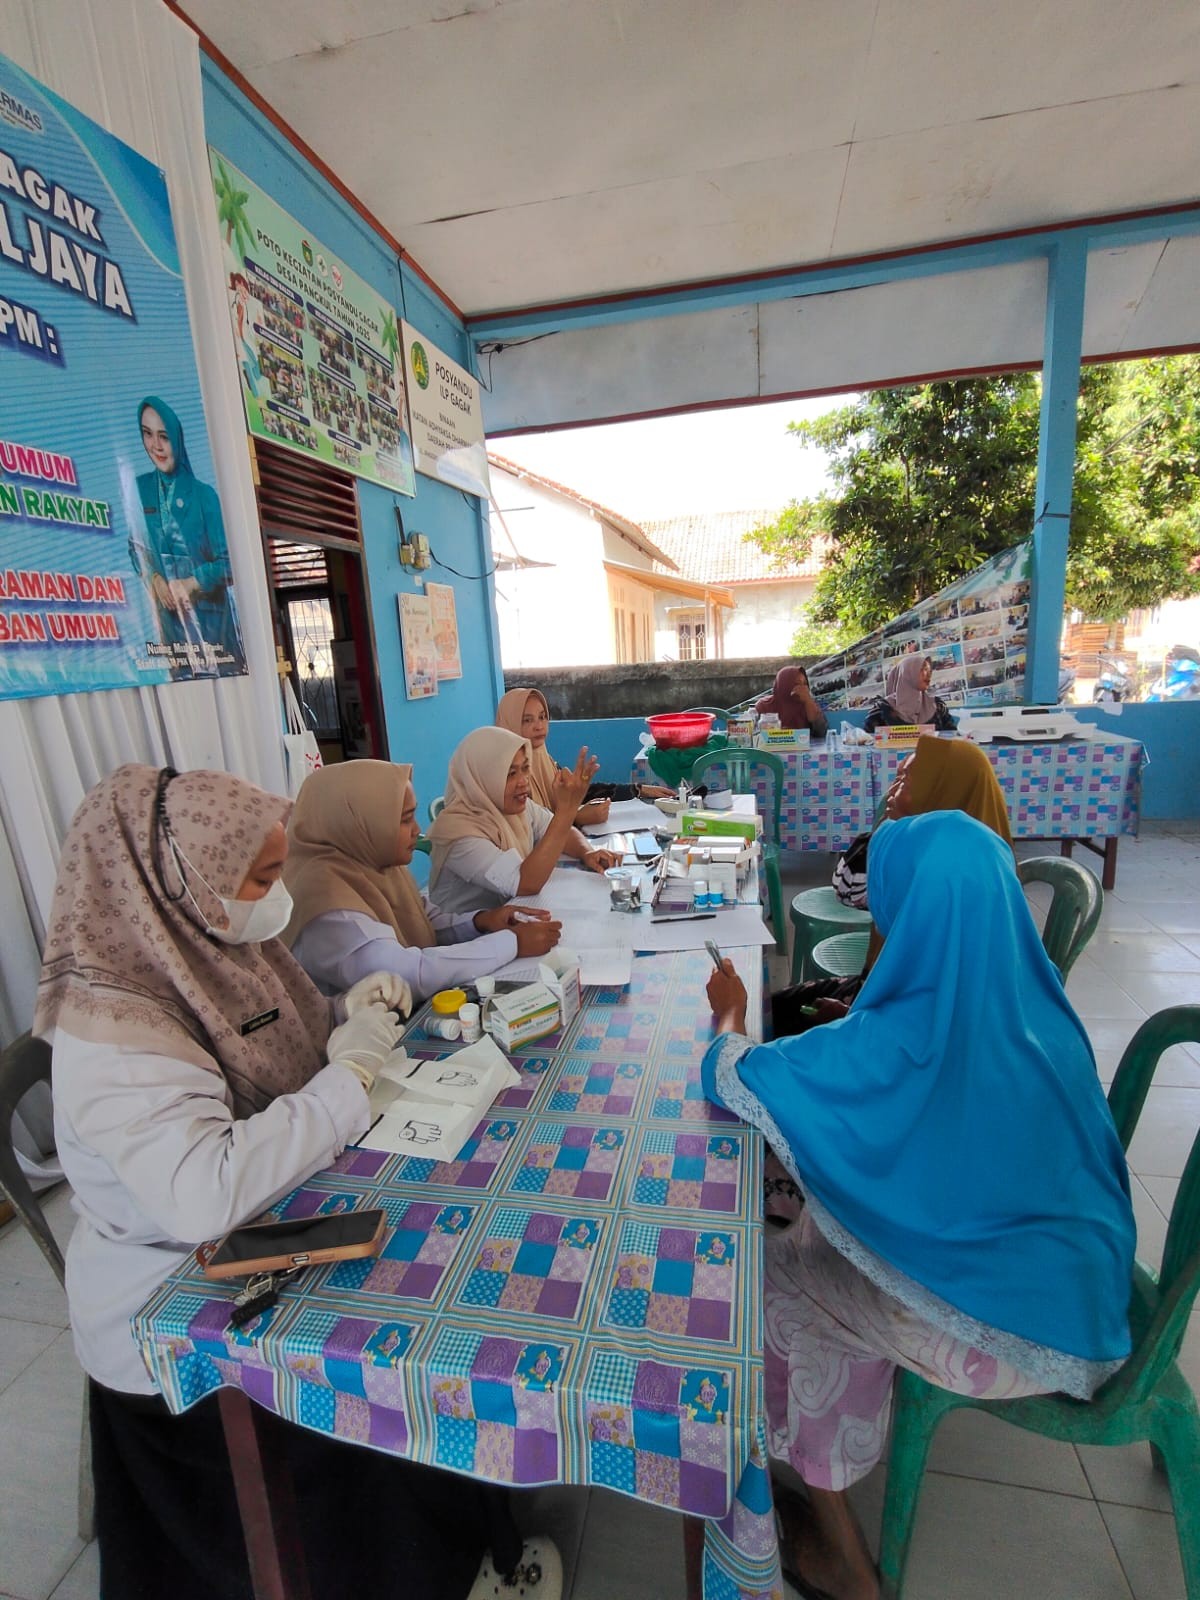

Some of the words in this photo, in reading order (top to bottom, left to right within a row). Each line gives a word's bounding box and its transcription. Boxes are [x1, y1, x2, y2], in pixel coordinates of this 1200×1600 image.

[0, 152, 102, 241] AGAK
[257, 228, 281, 257] POTO
[323, 281, 359, 318] POSYANDU
[276, 262, 297, 286] DESA
[333, 304, 355, 329] TAHUN
[435, 361, 473, 400] POSYANDU
[450, 392, 472, 417] GAGAK
[0, 441, 77, 486] UMUM
[21, 484, 110, 529] RAKYAT
[79, 574, 125, 603] DAN
[46, 612, 119, 641] UMUM
